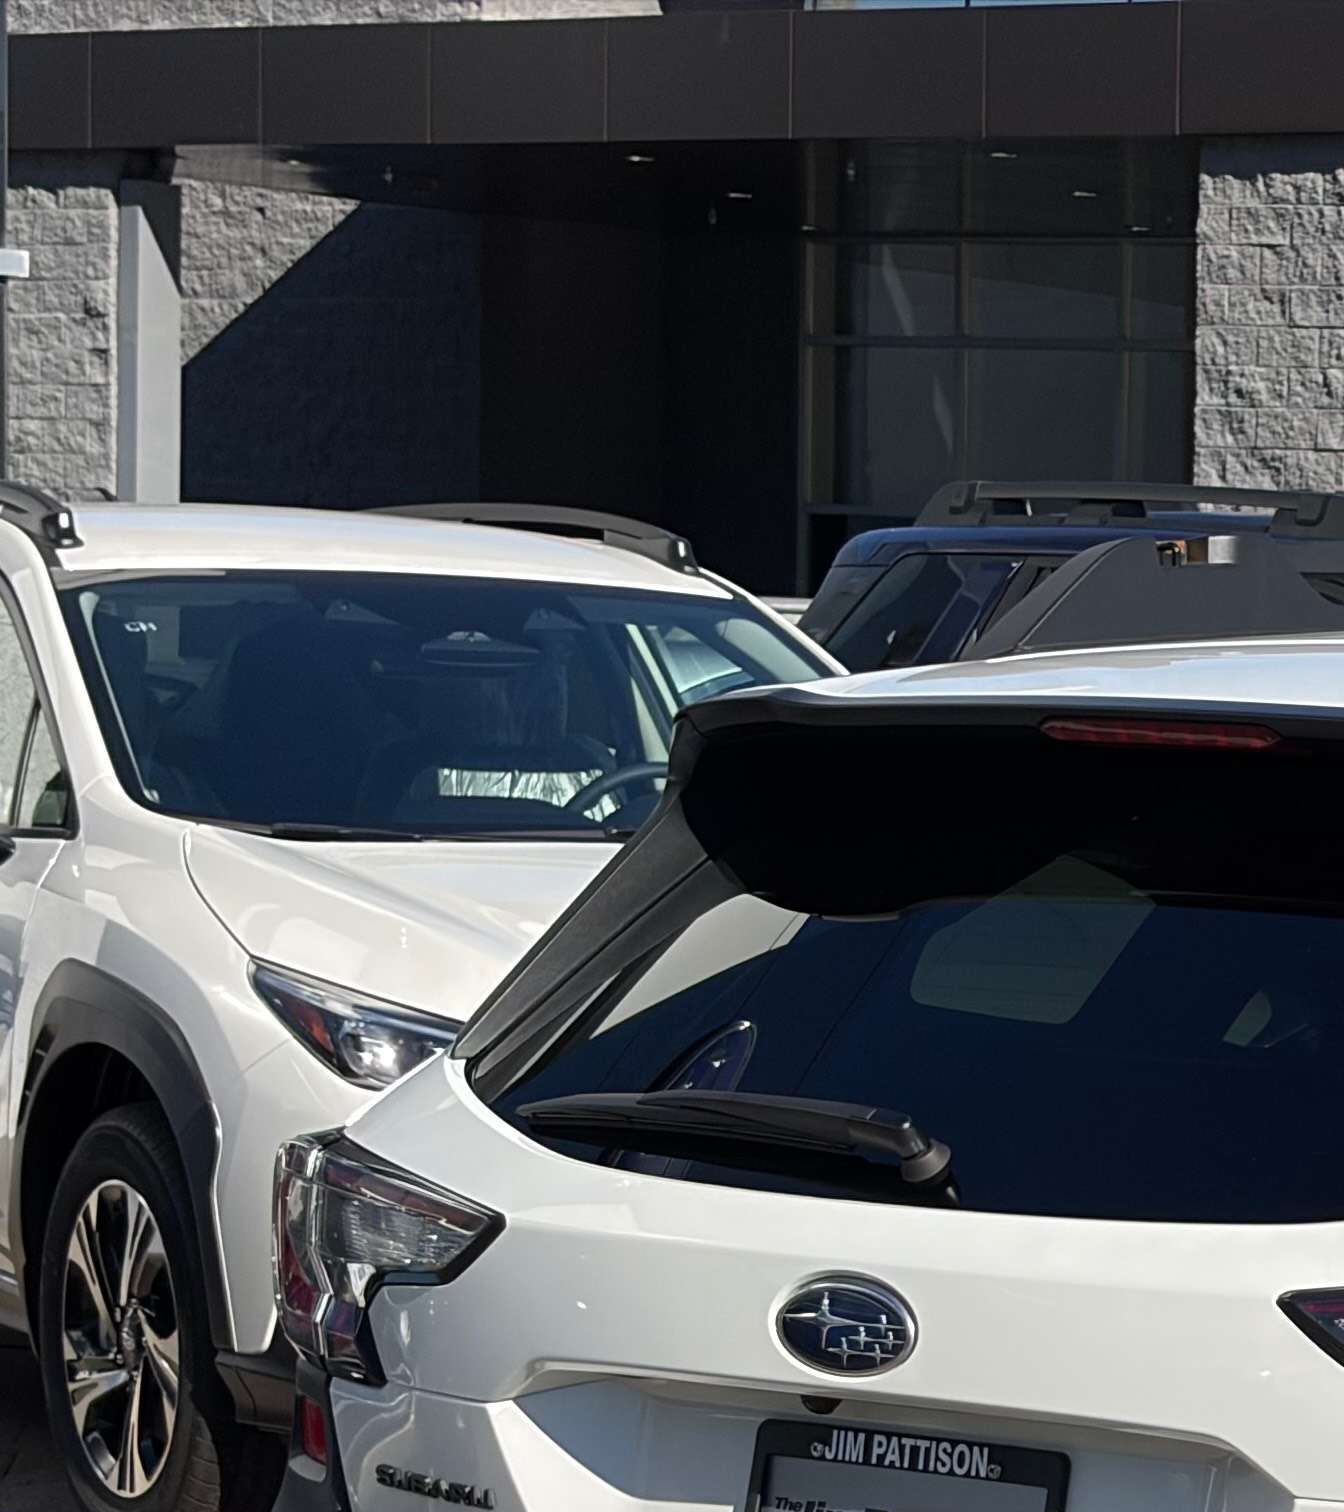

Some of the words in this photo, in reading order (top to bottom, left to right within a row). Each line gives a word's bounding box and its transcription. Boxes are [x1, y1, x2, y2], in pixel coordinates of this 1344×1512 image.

[824, 1429, 864, 1465] JIM
[871, 1434, 989, 1479] PATTISON
[775, 1496, 802, 1512] The
